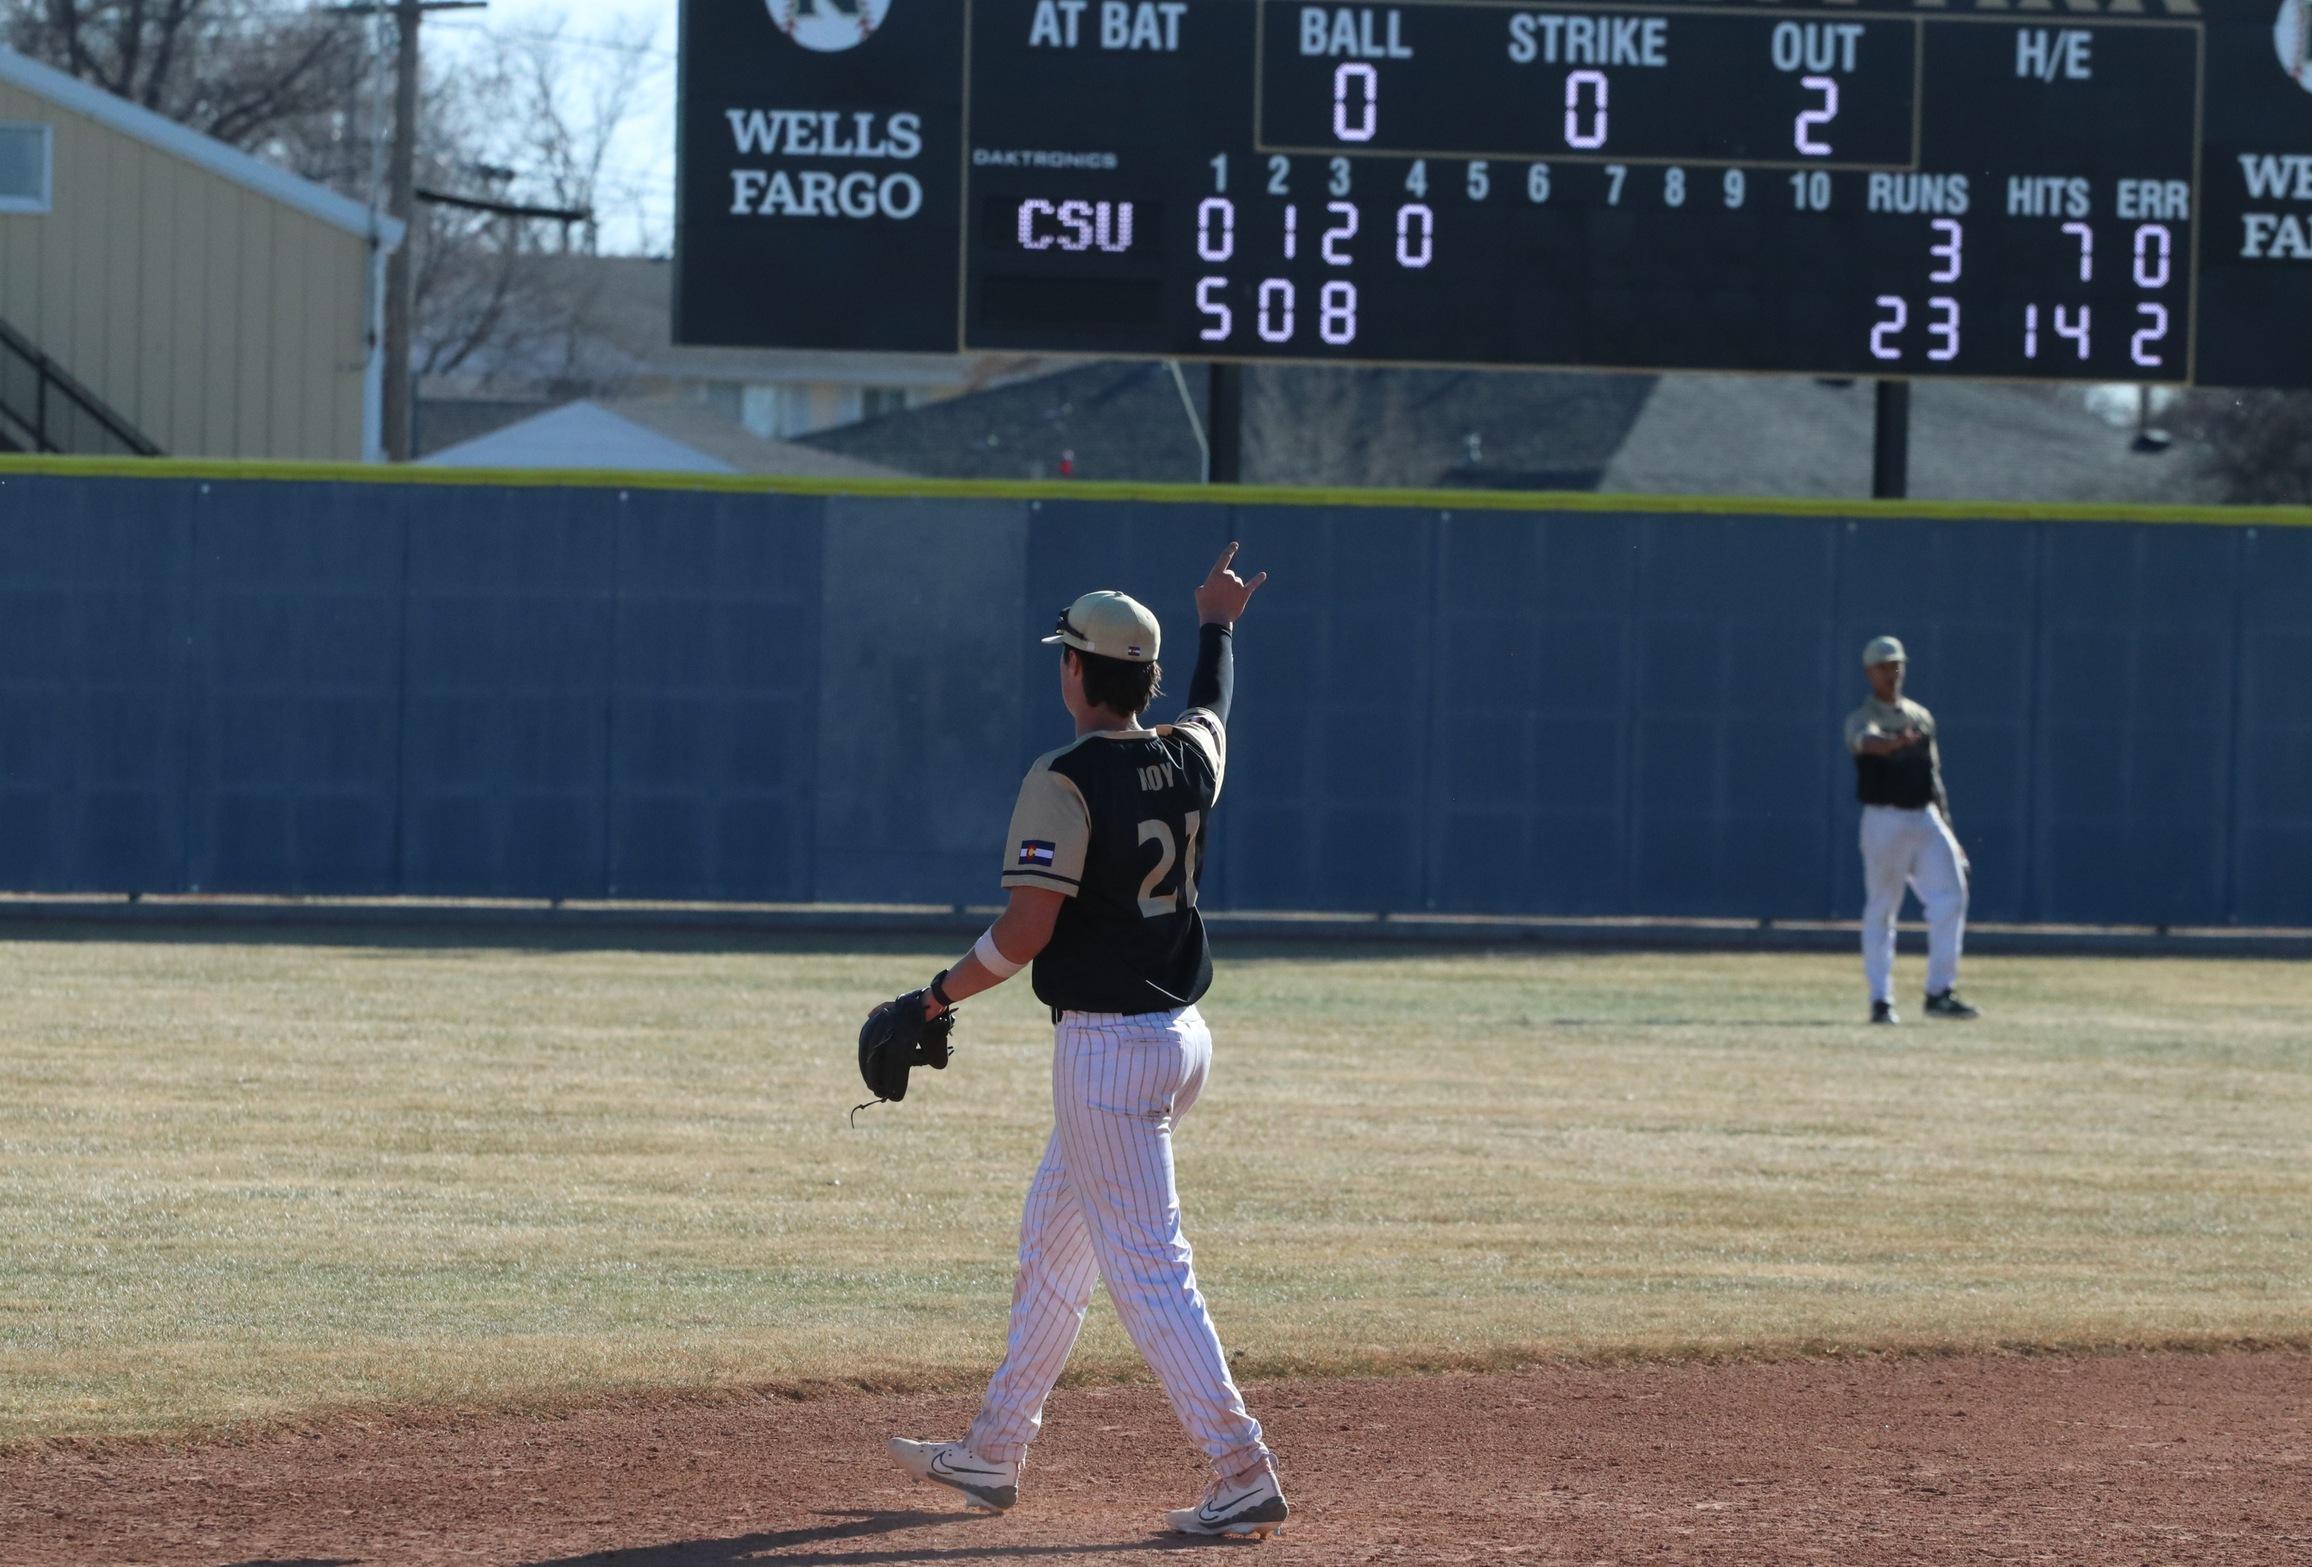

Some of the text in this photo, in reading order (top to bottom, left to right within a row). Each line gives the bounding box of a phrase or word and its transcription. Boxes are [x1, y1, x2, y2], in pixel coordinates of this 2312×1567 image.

[1029, 0, 1188, 51] AT BAT
[1300, 6, 1413, 59] BALL
[1508, 13, 1667, 67] STRIKE
[1771, 21, 1865, 73] OUT
[2016, 29, 2092, 82] H/E
[1333, 62, 1378, 142] 0
[1564, 70, 1609, 149] 0
[1794, 76, 1839, 156] 2
[725, 109, 922, 159] WELLS
[972, 148, 1118, 169] DAKTRONICS
[730, 169, 923, 219] FARGO
[1210, 153, 2190, 220] 1 2 3 4 5 6 7 8 9 10 RUNS HITS ERR
[1017, 197, 2171, 289] CSU 0 1 2 0 3 7 0
[1196, 276, 1232, 341] 5
[1257, 277, 1296, 343] 0
[1319, 280, 1357, 345] 8
[2130, 302, 2168, 367] 2
